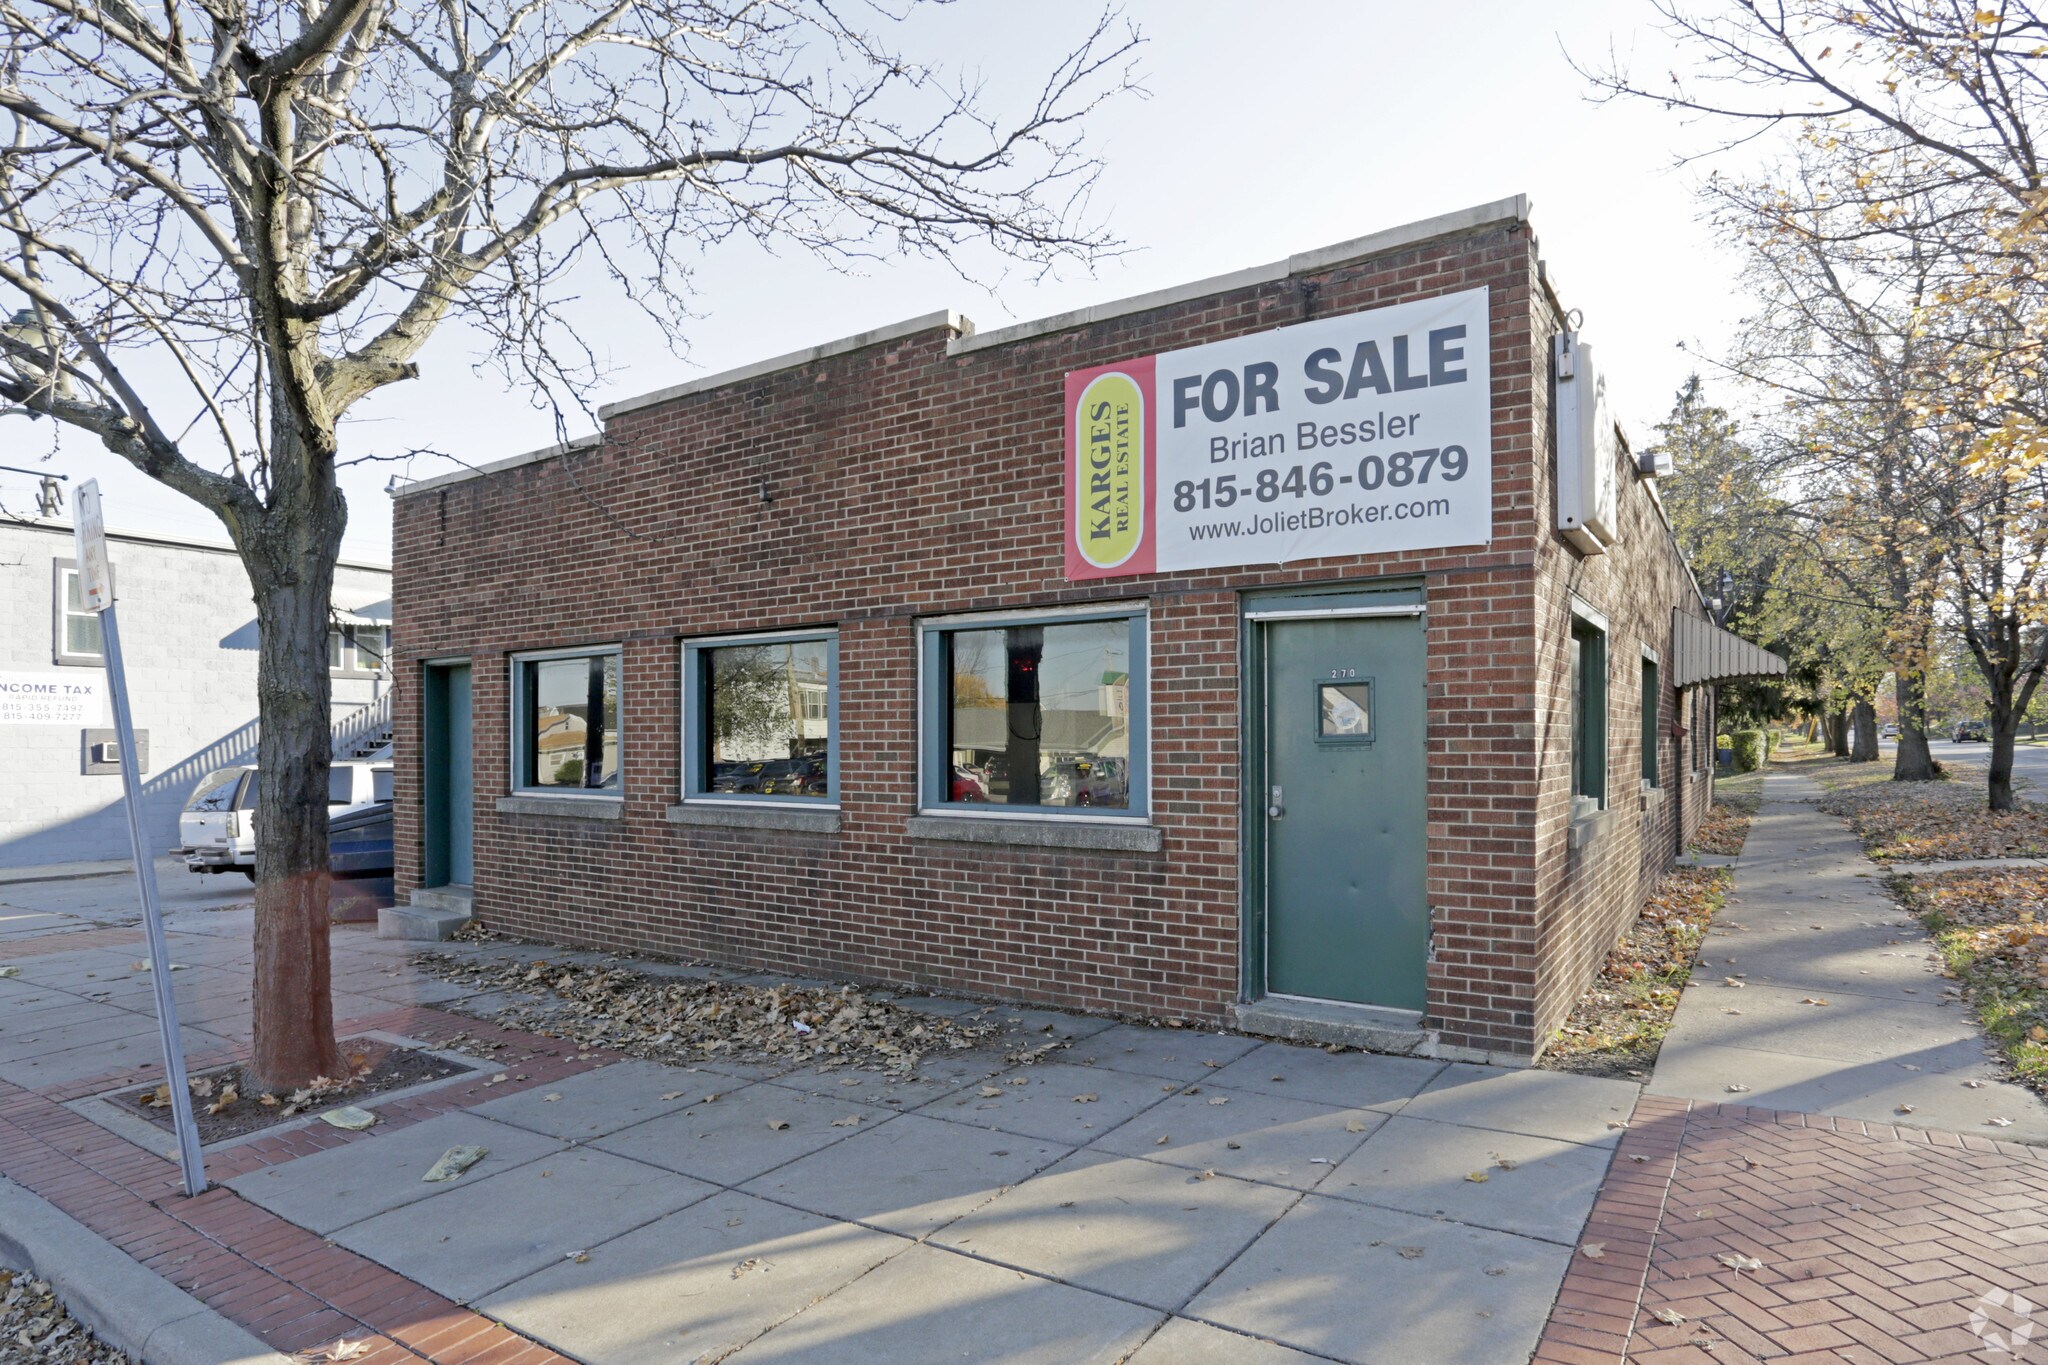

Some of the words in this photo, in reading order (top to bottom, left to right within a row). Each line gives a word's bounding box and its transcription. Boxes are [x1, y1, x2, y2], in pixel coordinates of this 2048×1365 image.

[1173, 361, 1281, 429] FOR
[1303, 323, 1468, 405] SALE
[1116, 402, 1129, 476] ESTATE
[1210, 433, 1285, 464] Brian
[1296, 411, 1421, 451] Bessler
[1090, 400, 1112, 542] KARGES
[1173, 444, 1469, 513] 815-846-0879
[1116, 481, 1129, 532] REAL
[1188, 498, 1450, 541] www.JolietBroker.com
[63, 685, 93, 695] TAX
[1331, 668, 1356, 679] 270
